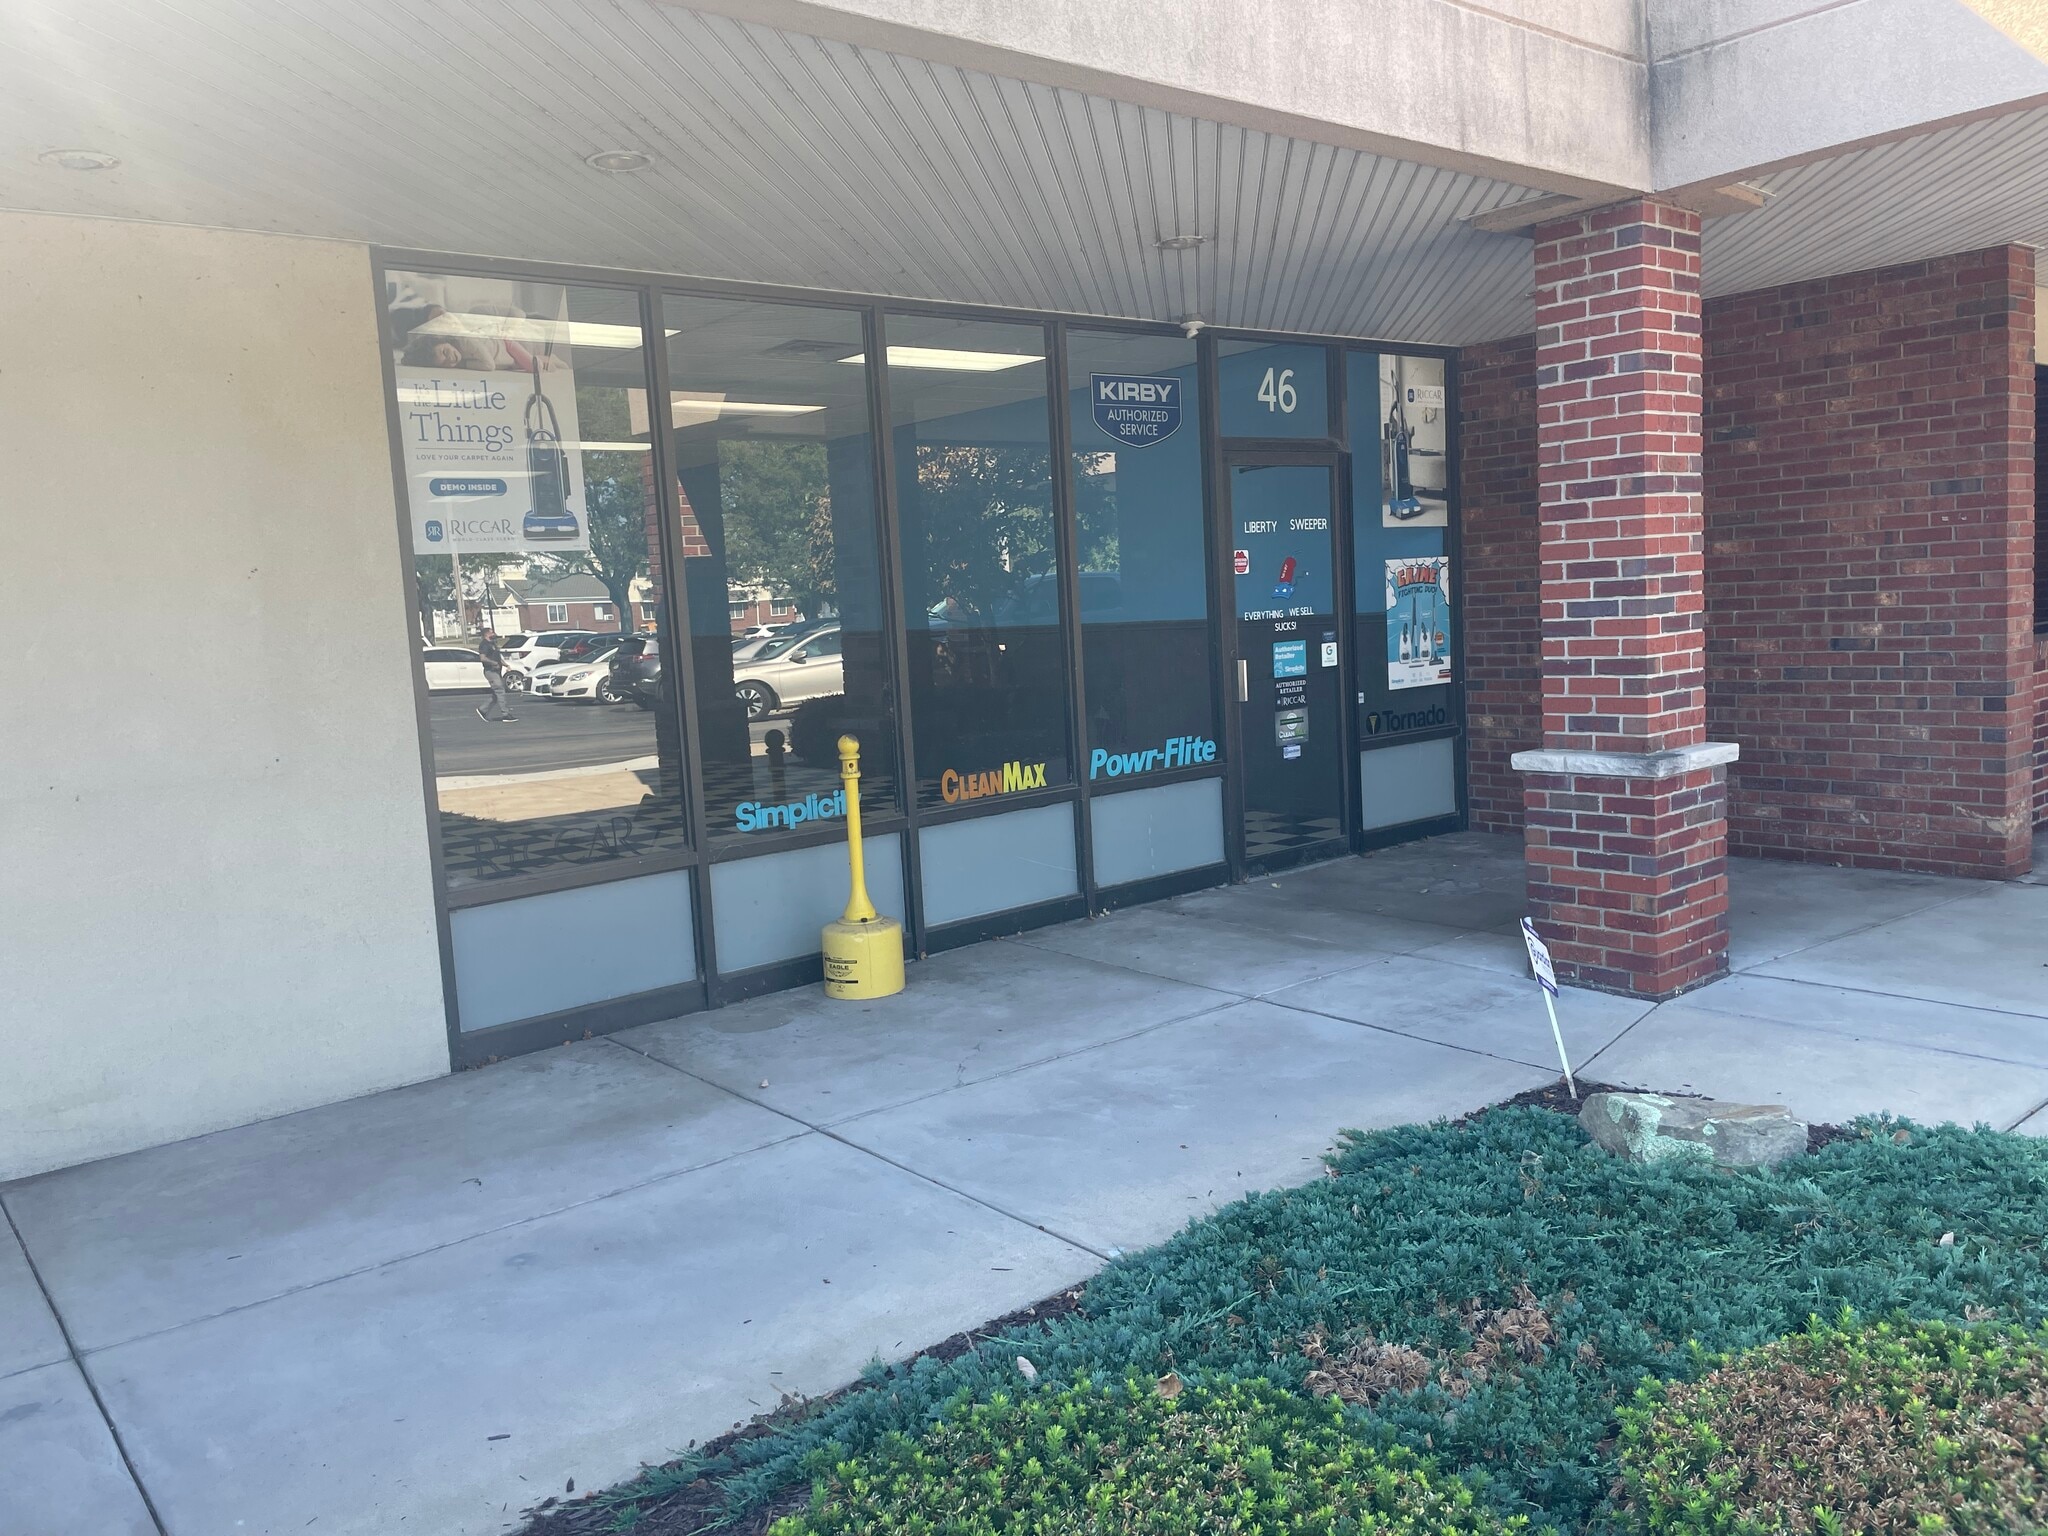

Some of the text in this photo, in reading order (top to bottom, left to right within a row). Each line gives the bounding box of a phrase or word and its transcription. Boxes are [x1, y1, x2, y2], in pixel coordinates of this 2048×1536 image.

[431, 379, 506, 410] Little
[1099, 381, 1173, 403] KIRBY
[1257, 367, 1297, 414] 46
[1417, 388, 1443, 401] RICCAR
[1107, 409, 1169, 423] AUTHORIZED
[409, 411, 514, 452] Things
[1119, 424, 1159, 436] SERVICE
[440, 483, 466, 491] DEMO
[450, 518, 515, 536] RICCAR
[1244, 518, 1328, 534] LIBERTY SWEEPER
[1244, 606, 1315, 621] EVERYTHING WE SELL
[1274, 621, 1297, 632] SUCKS!
[1274, 644, 1304, 653] Authorized
[1275, 680, 1306, 689] AUTHORIZED
[1279, 686, 1303, 694] RETAILER
[1283, 695, 1306, 706] RICCAR
[1382, 704, 1446, 732] Tornado
[1089, 735, 1217, 780] Powr-Flite
[735, 789, 862, 832] Simplicit
